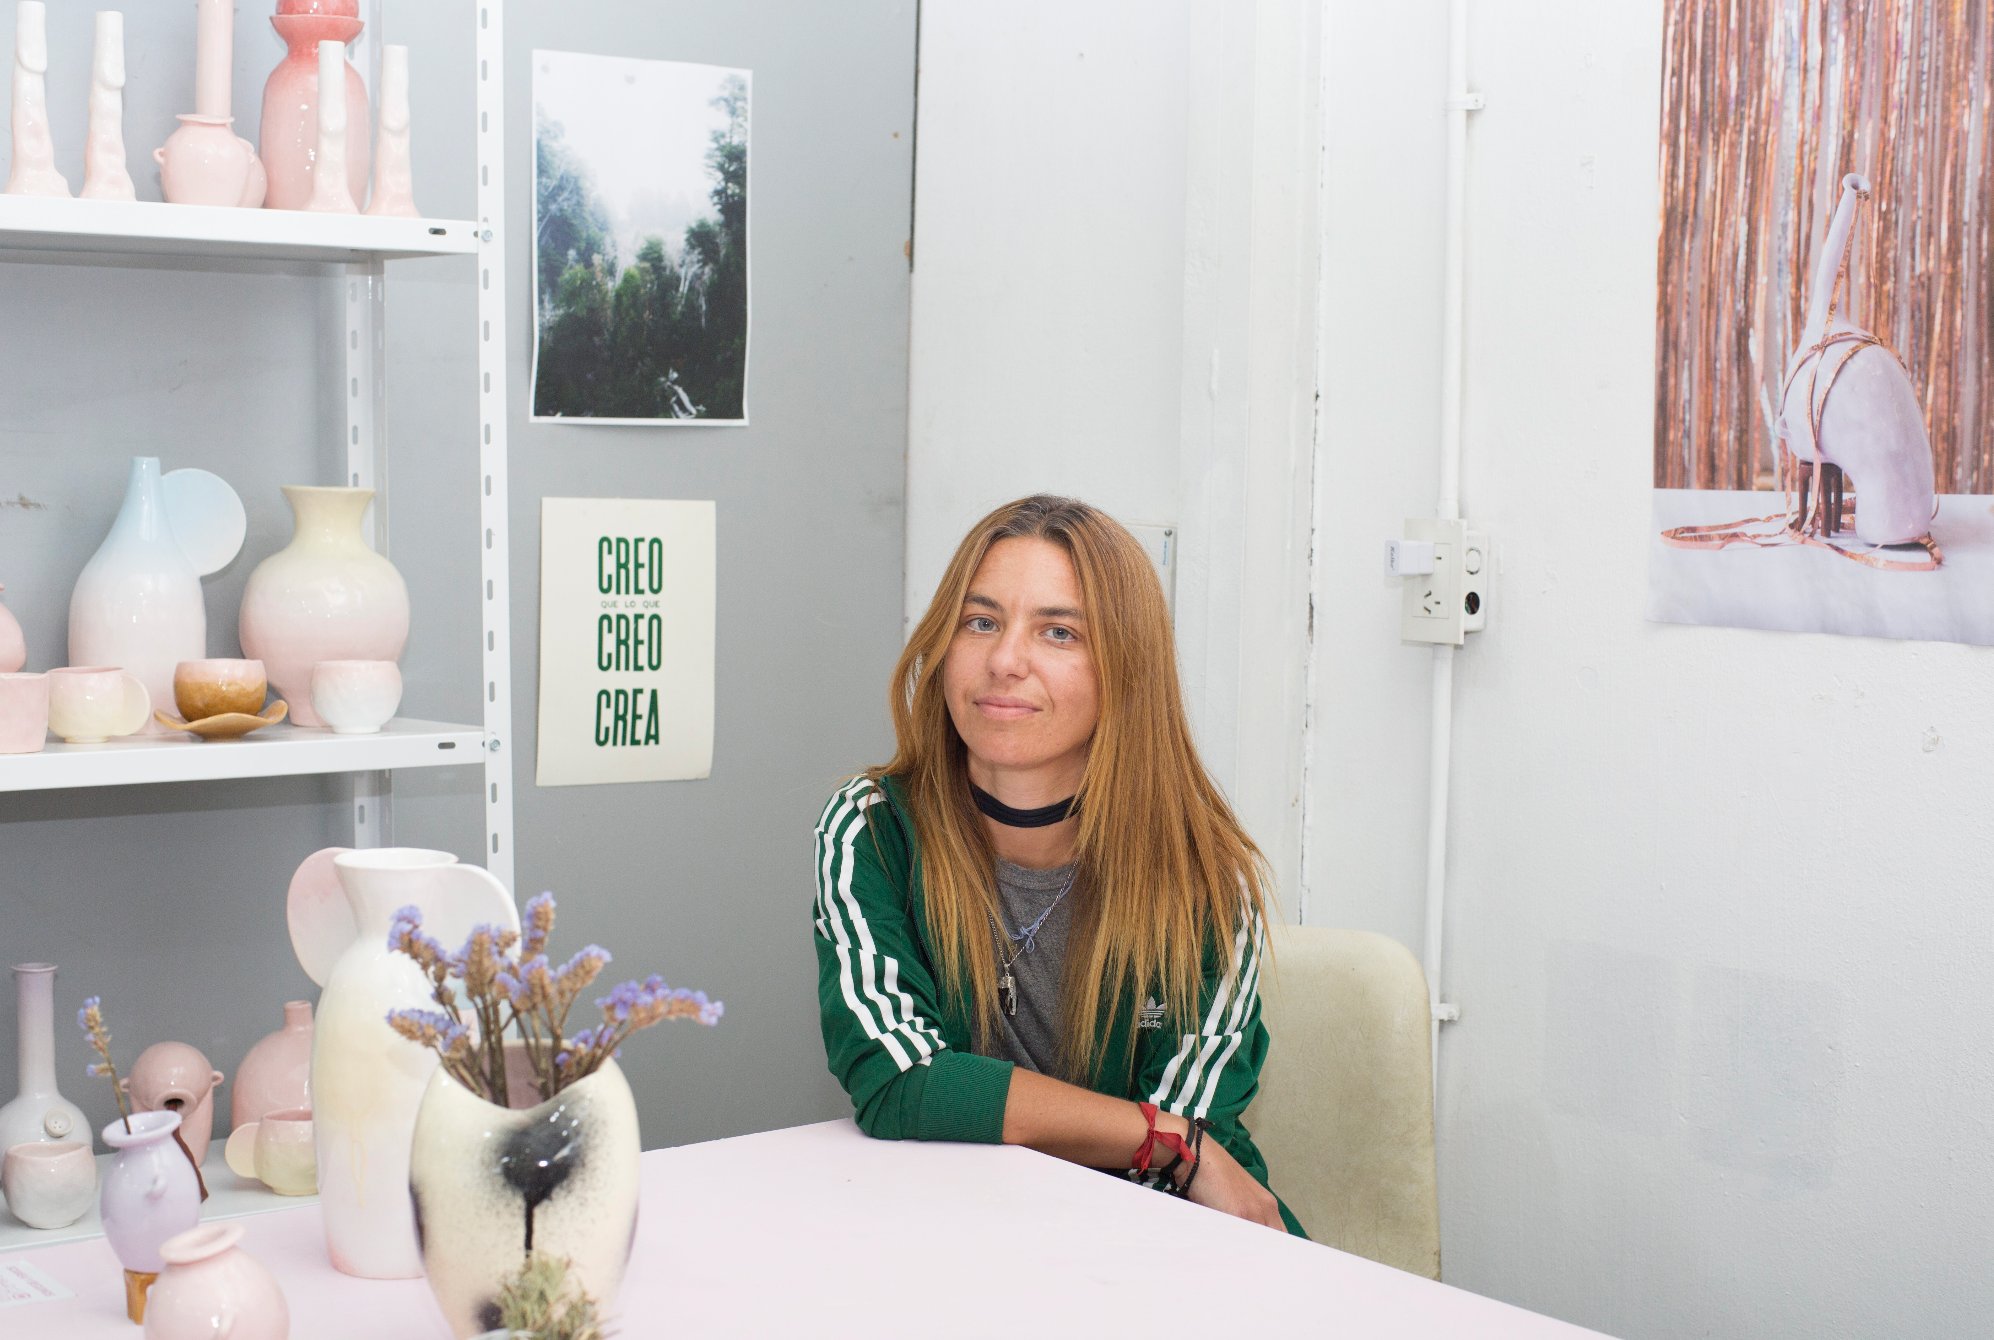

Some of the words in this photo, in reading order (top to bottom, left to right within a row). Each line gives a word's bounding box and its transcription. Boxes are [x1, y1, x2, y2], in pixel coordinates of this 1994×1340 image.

[598, 536, 663, 595] CREO
[600, 600, 618, 608] QUE
[624, 600, 637, 608] LO
[642, 600, 661, 608] QUE
[597, 613, 662, 671] CREO
[595, 688, 659, 746] CREA
